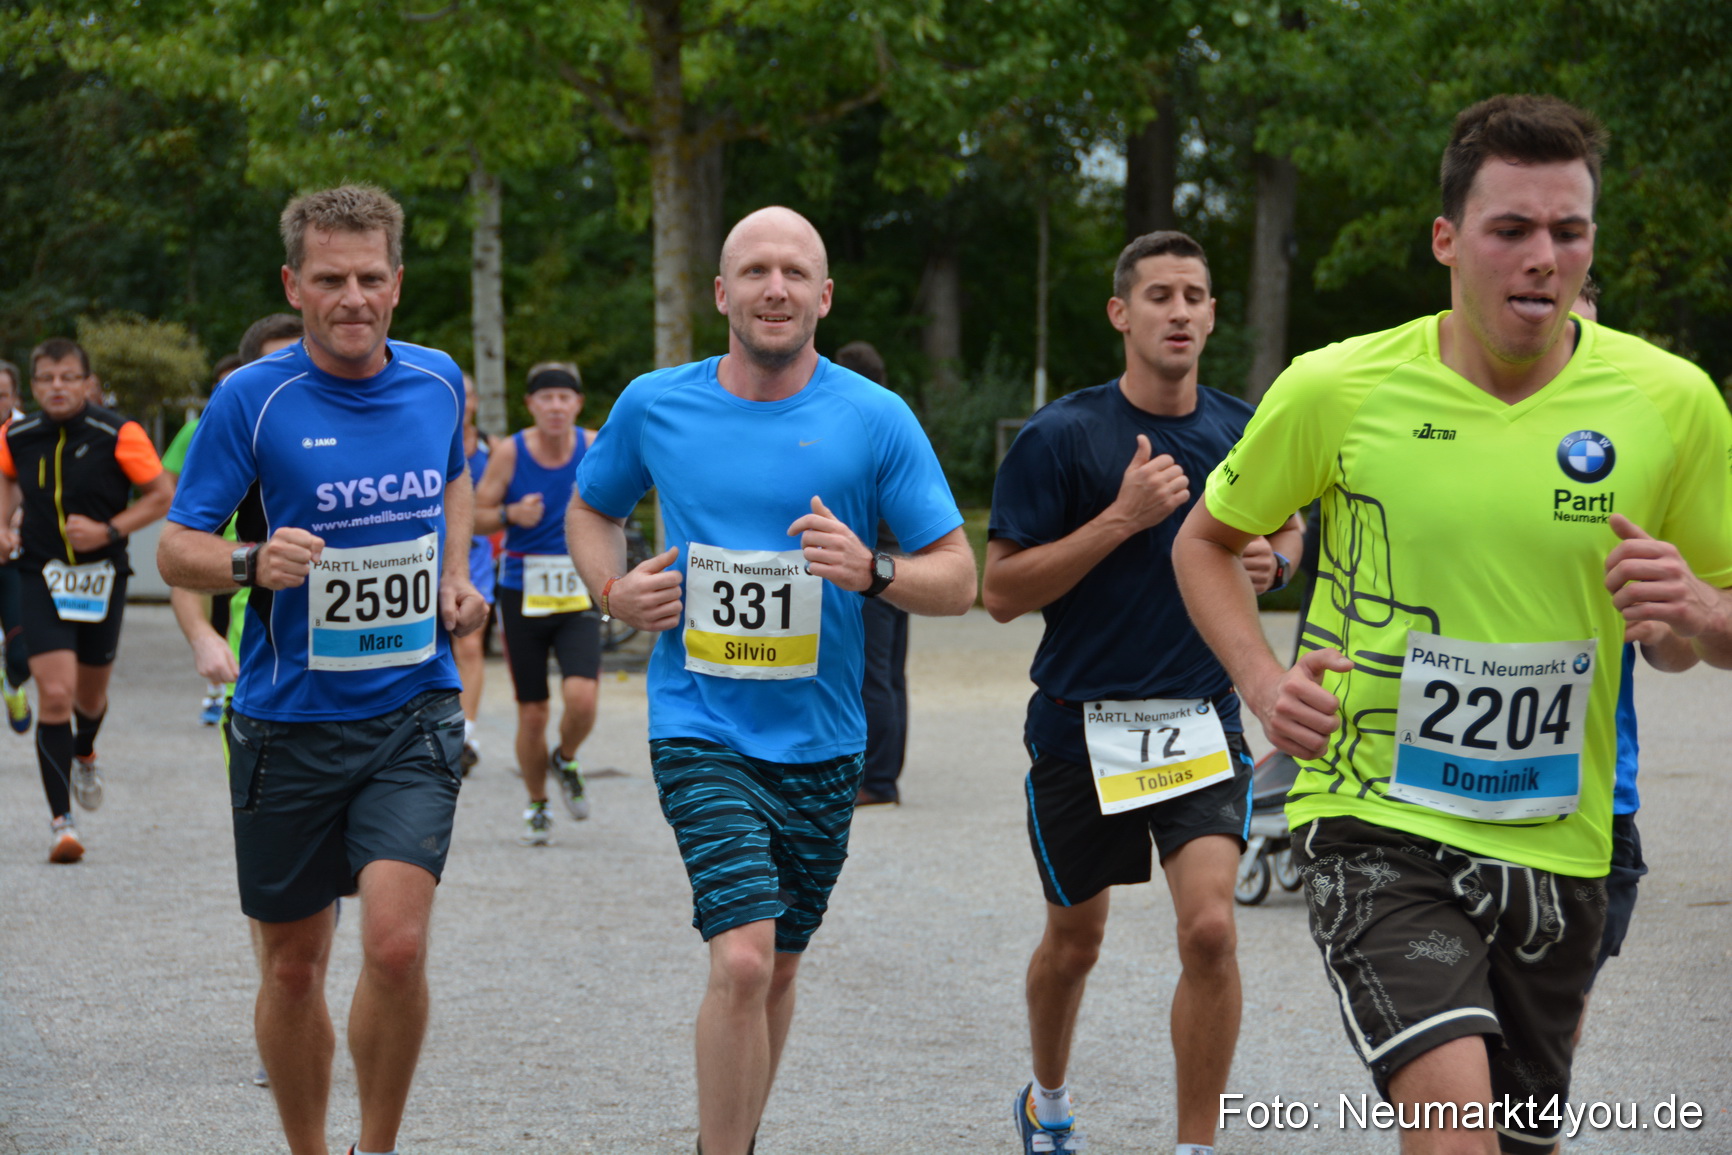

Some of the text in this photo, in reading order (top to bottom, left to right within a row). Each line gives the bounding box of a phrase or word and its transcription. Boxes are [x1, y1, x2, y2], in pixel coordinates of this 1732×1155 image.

[314, 437, 337, 447] JAKO
[1562, 431, 1611, 449] BMW
[316, 469, 442, 512] SYSCAD
[1554, 489, 1615, 513] Partl
[312, 504, 442, 531] www.metallbau-cad.d
[1553, 511, 1610, 524] Neumark
[313, 553, 422, 572] PARTL Neumarkt
[690, 556, 800, 576] PARTL Neumarkt
[49, 570, 106, 596] 2040
[325, 569, 430, 623] 2590
[712, 580, 792, 630] 331
[359, 634, 403, 652] Marc
[724, 641, 776, 662] Silvio
[1411, 647, 1567, 677] PARTL Neumarkt
[1088, 707, 1192, 723] PARTL Neumarkt
[1419, 679, 1574, 751] 2204
[1127, 727, 1186, 763] 72
[1136, 769, 1194, 792] Tobias
[1442, 762, 1541, 794] Dominik
